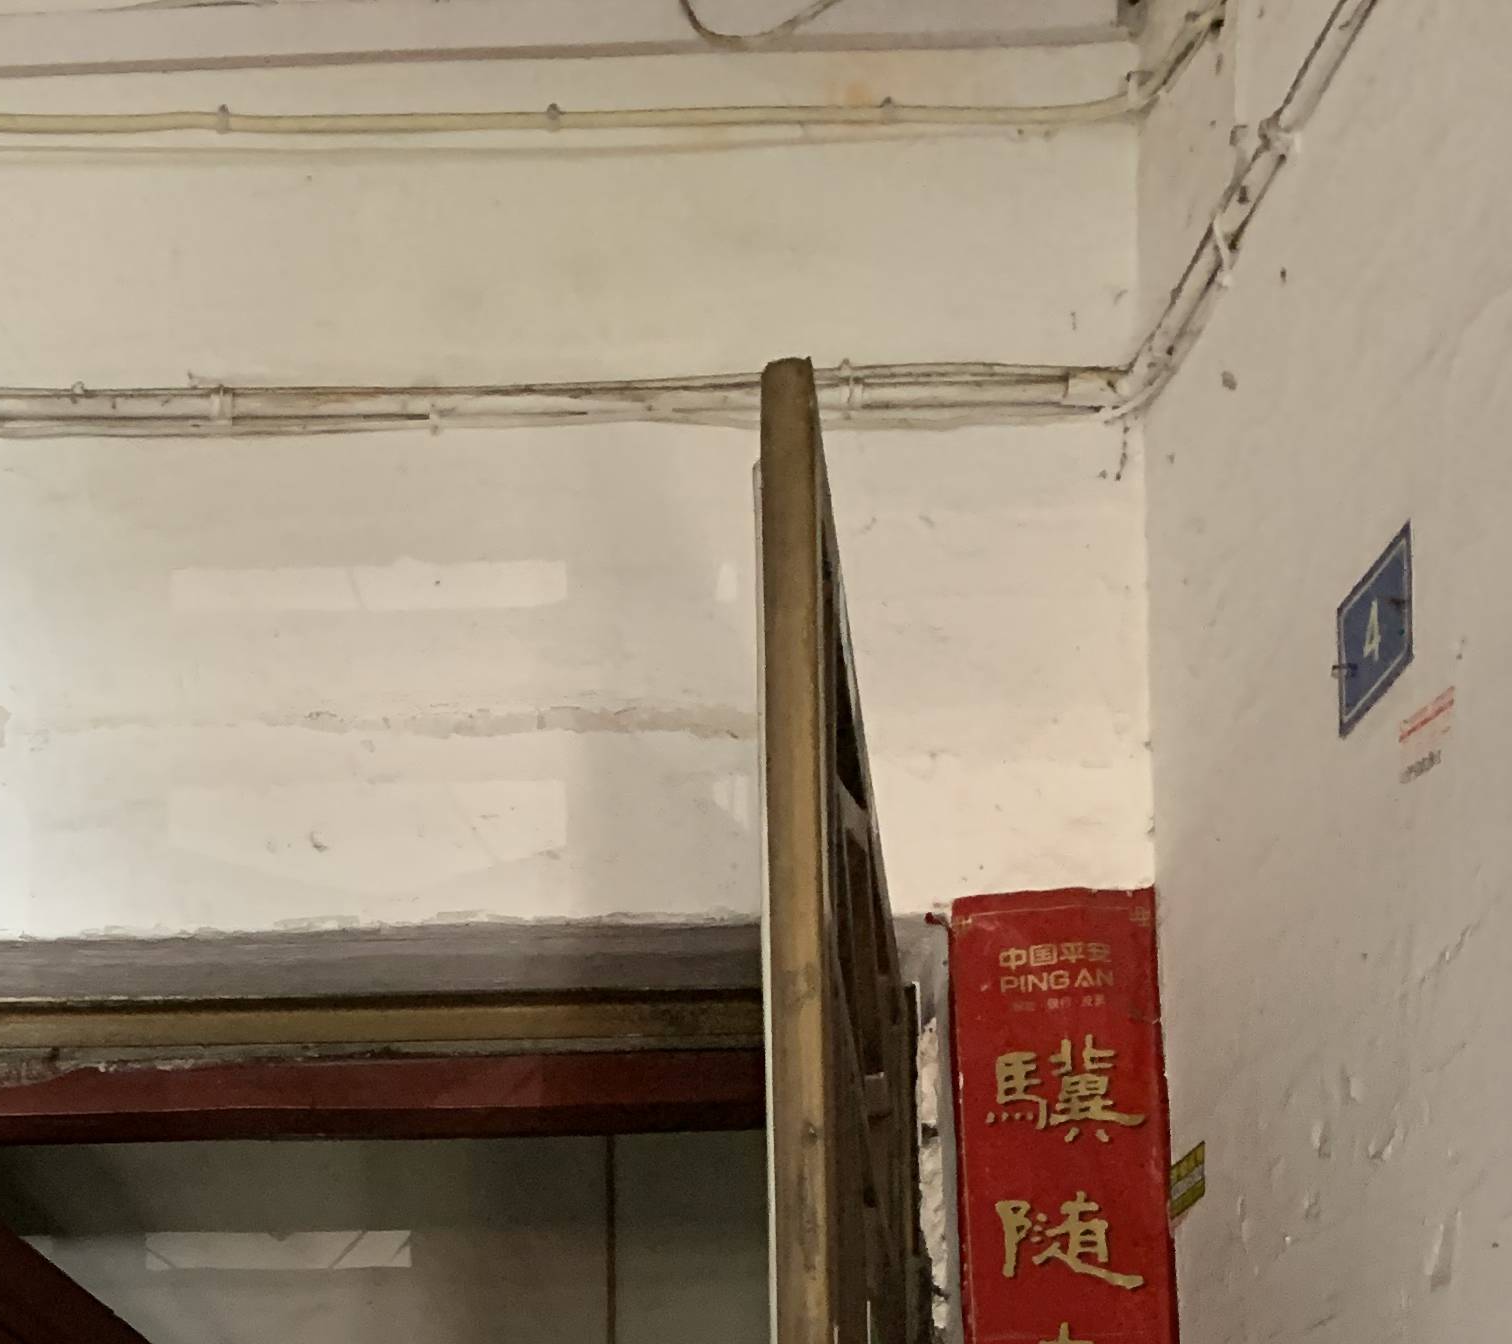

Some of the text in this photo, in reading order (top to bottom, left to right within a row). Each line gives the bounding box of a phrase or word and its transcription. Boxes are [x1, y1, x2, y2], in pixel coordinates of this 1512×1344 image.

[999, 942, 1112, 971] 中国平安
[1000, 969, 1070, 993] PING
